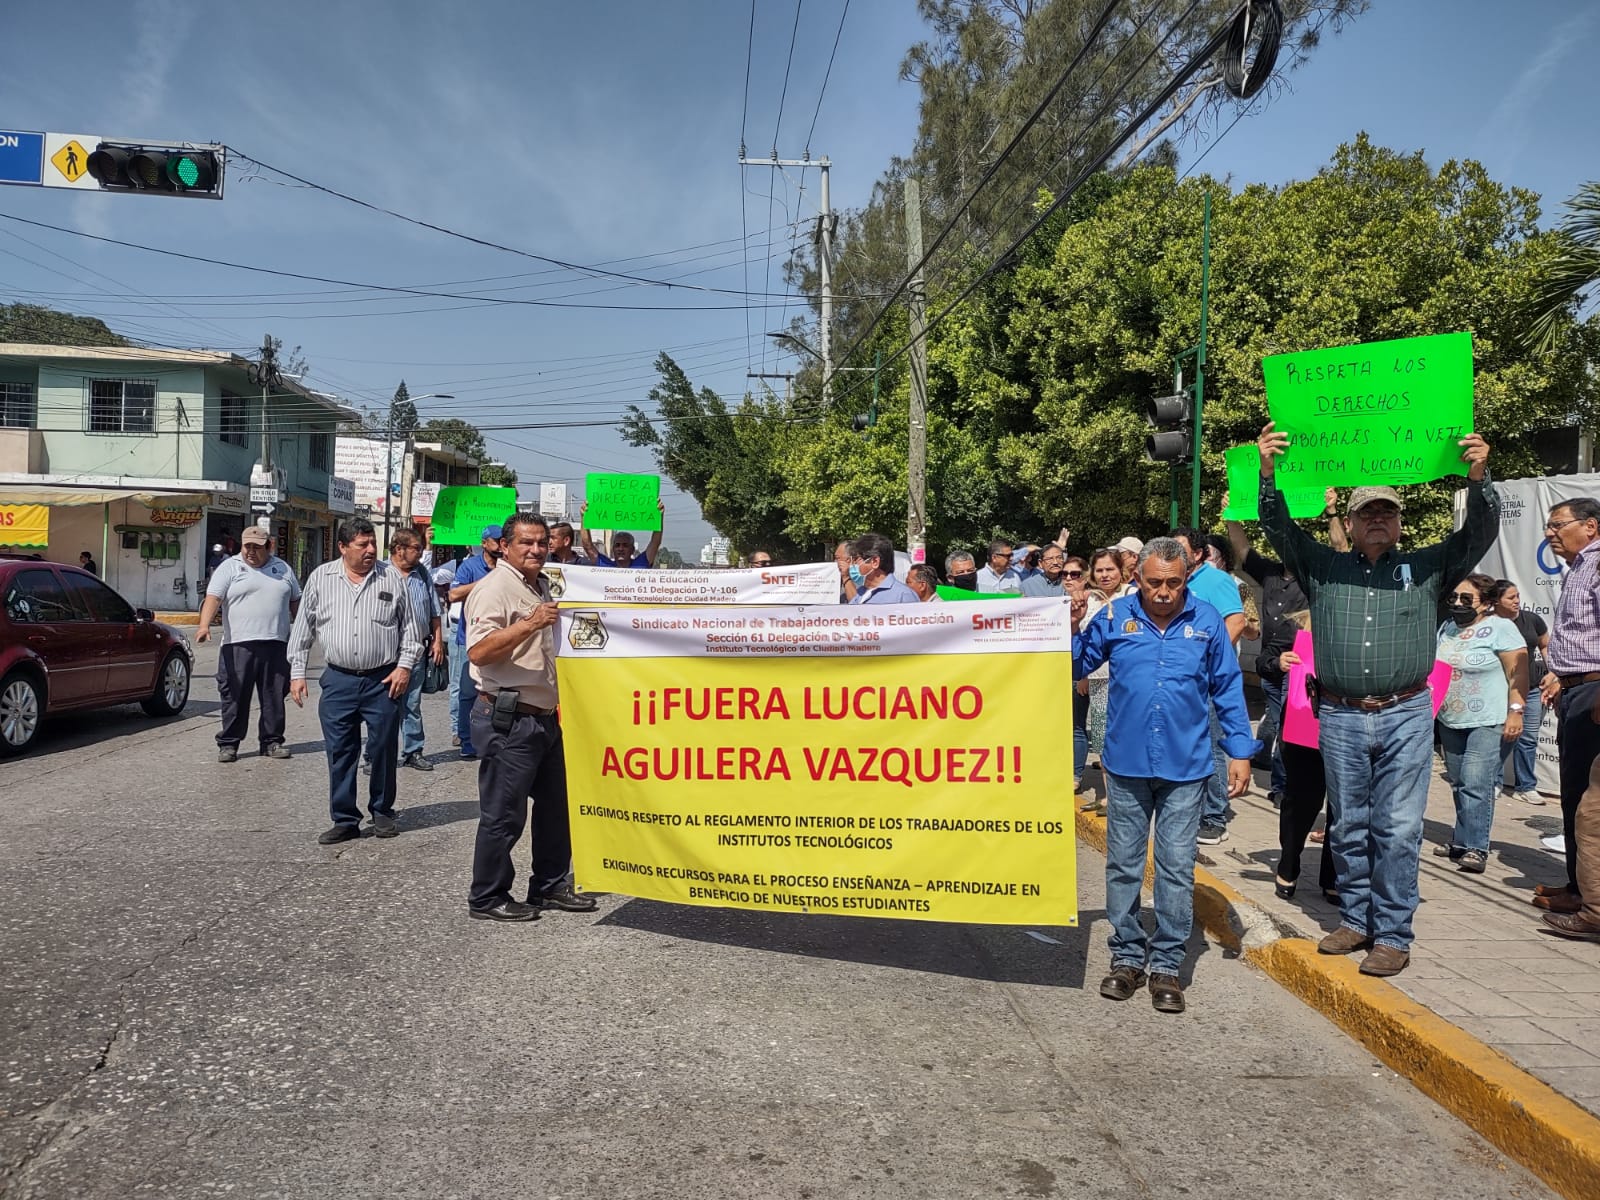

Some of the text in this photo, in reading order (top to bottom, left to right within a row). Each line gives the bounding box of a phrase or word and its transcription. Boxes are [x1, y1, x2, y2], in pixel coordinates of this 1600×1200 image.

[1286, 357, 1426, 384] RESPETA LOS
[1316, 392, 1411, 412] DERECHOS
[1388, 426, 1413, 442] YA
[1426, 425, 1465, 444] VETE
[1278, 456, 1424, 474] DEL ITCM LUCIANO
[597, 478, 652, 490] FUERA
[334, 488, 352, 500] COPIAS
[592, 492, 657, 506] DIRECTOR
[596, 510, 656, 522] YA BASTA
[660, 576, 708, 584] Educación
[761, 572, 795, 585] SNTE
[650, 586, 698, 595] Delegación
[632, 612, 954, 630] Sindicato Nacional de Trabajadores de la Educación
[972, 614, 1012, 630] SNTE
[706, 632, 880, 644] Sección 61 Delegación D-V-106
[746, 645, 796, 653] Tecnológico
[632, 685, 983, 725] ¡¡FUERA LUCIANO
[601, 746, 1022, 787] AGUILERA VAZQUEZ!!
[580, 805, 1062, 834] EXIGIMOS RESPETO AL REGLAMENTO INTERIOR DE LOS TRABAJADORES DE LOS
[718, 834, 892, 850] INSTITUTOS TECNOLÓGICOS
[603, 858, 653, 876] EXIGIMOS
[656, 867, 714, 882] RECURSOS
[718, 873, 750, 885] PARA
[754, 874, 767, 886] EL
[770, 875, 828, 888] PROCESO
[832, 875, 910, 891] ENSEÑANZA
[926, 880, 1017, 896] APRENDIZAJE
[1022, 884, 1040, 896] EN
[689, 887, 930, 912] BENEFICIO DE NUESTROS ESTUDIANTES
